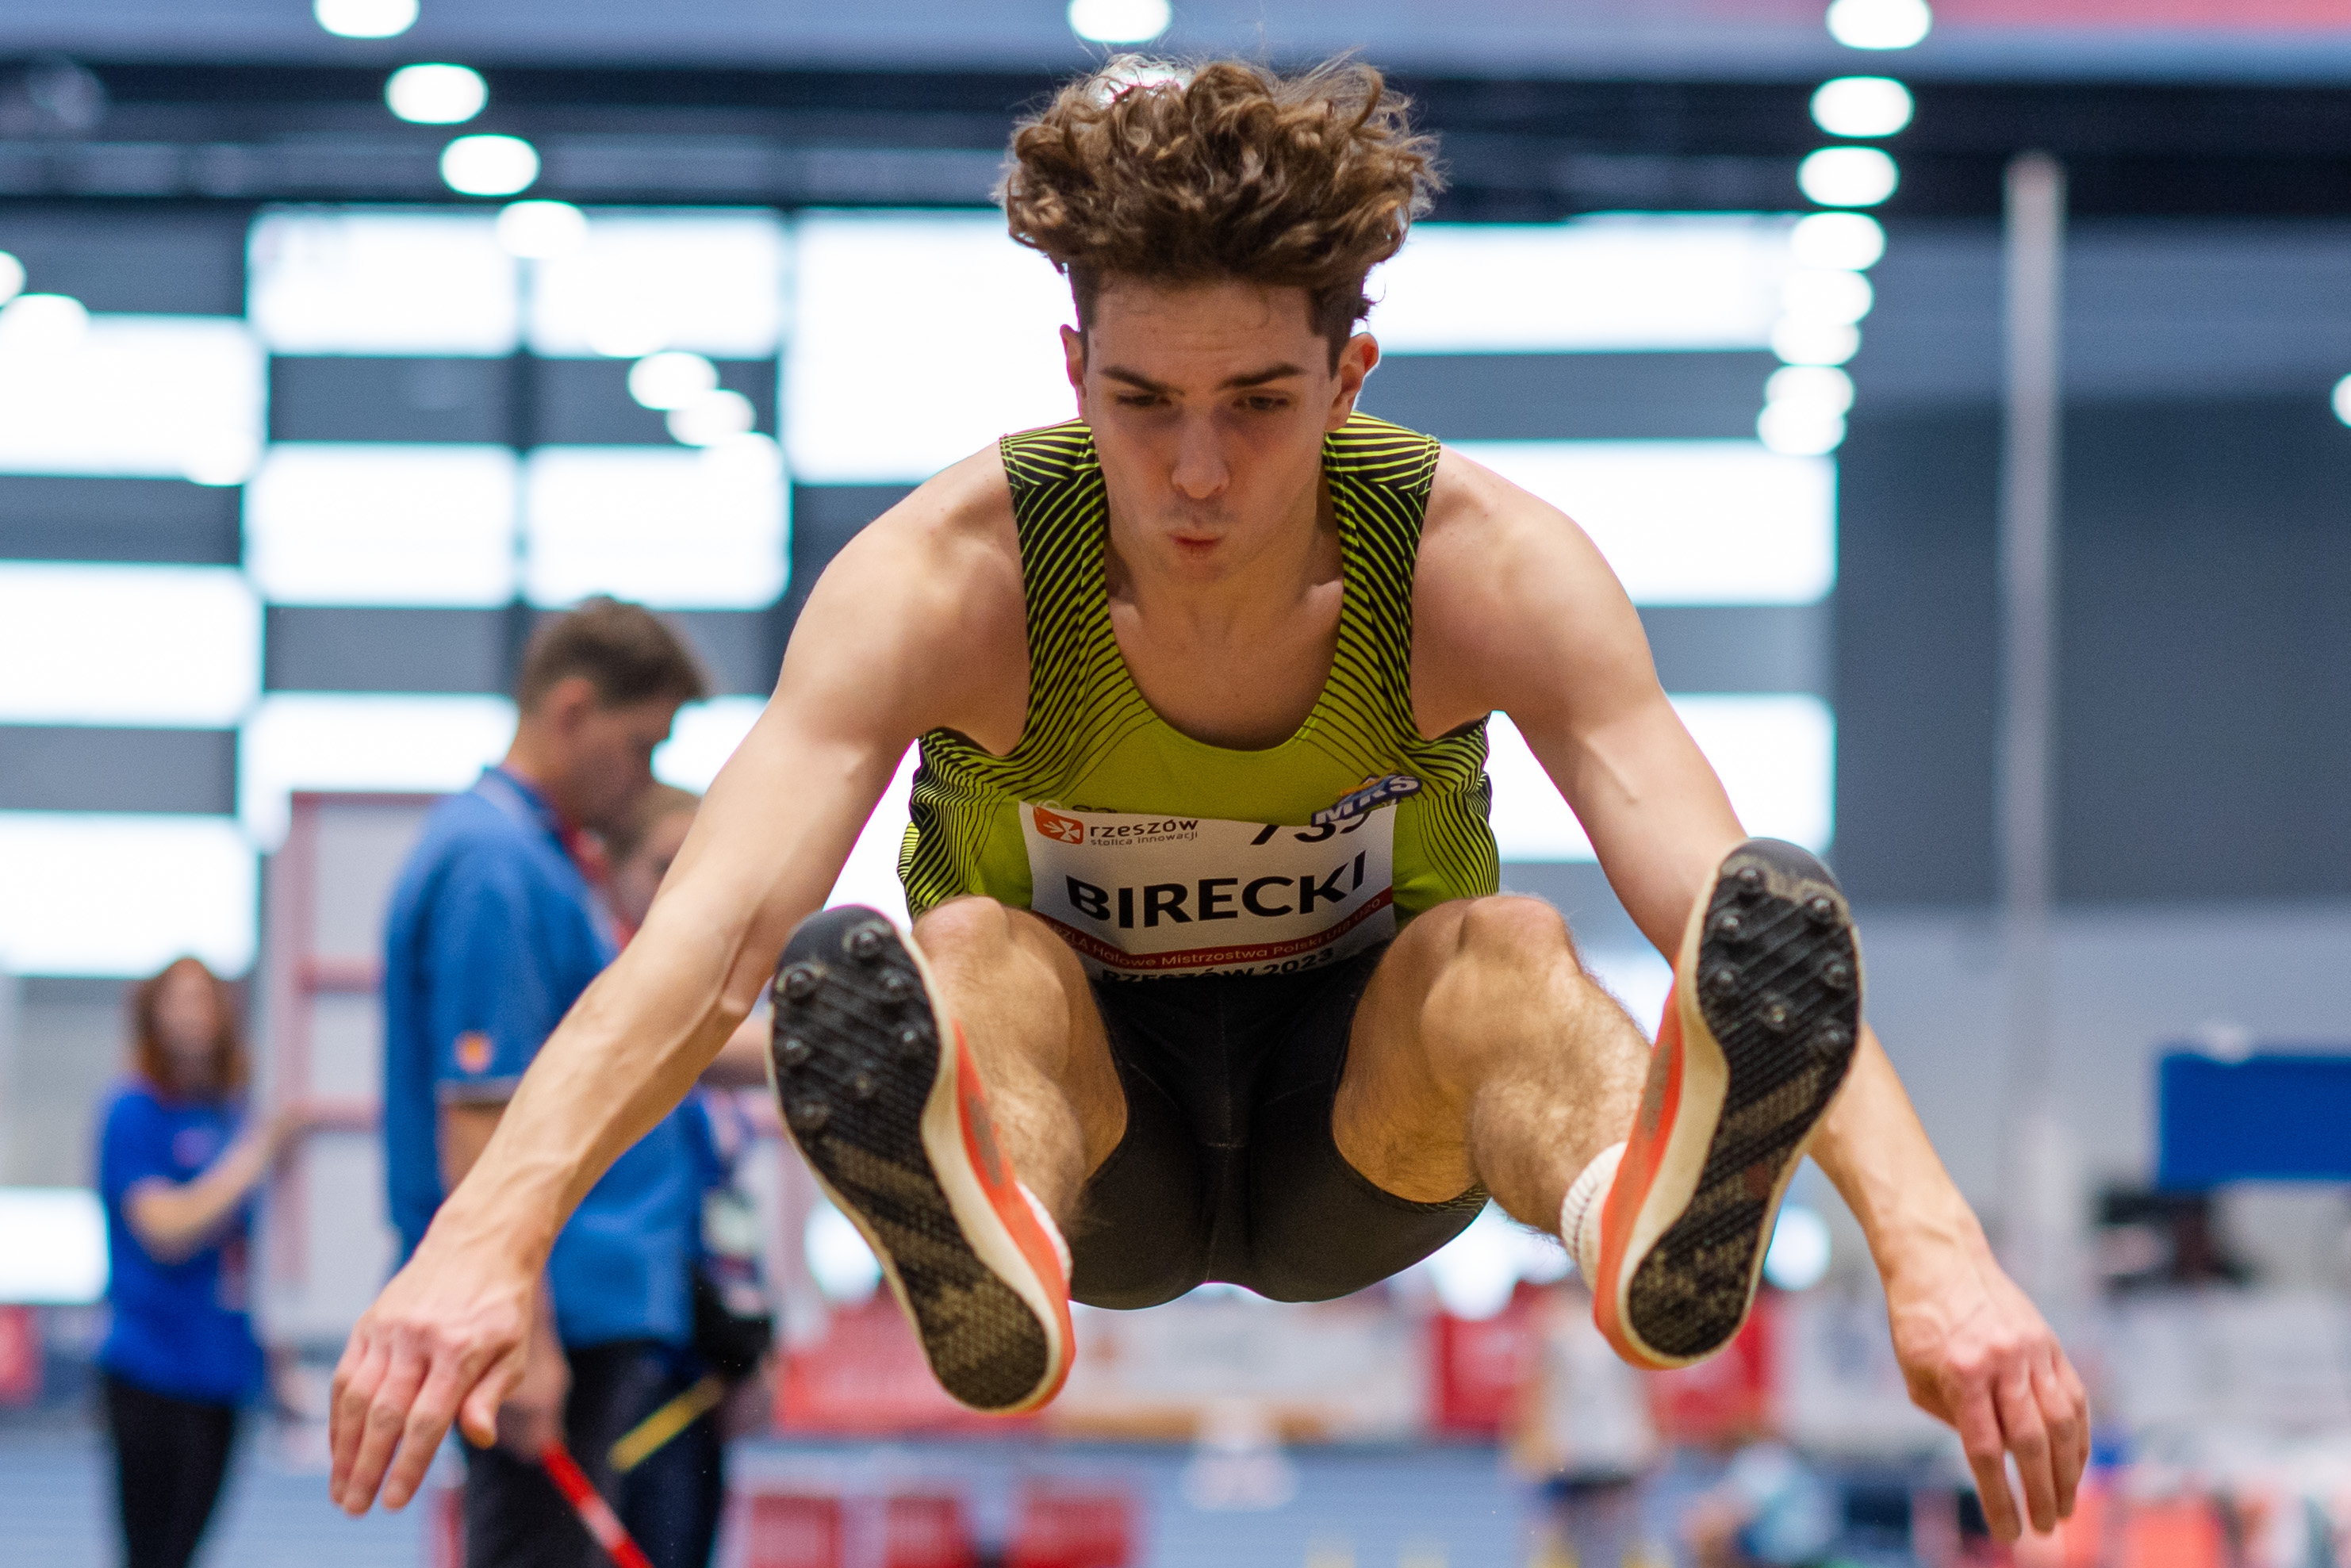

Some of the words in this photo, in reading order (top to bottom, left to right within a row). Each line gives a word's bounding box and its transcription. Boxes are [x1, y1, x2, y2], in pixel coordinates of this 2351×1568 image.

[1090, 811, 1199, 838] rzeszów
[1091, 837, 1133, 846] stolica
[1137, 830, 1198, 845] innowacji
[1066, 850, 1366, 929] BIRECKI
[1091, 944, 1156, 967] Halowe
[1161, 947, 1268, 965] Mistrzostwa
[1272, 937, 1323, 955] Polski
[1263, 947, 1333, 977] 2023
